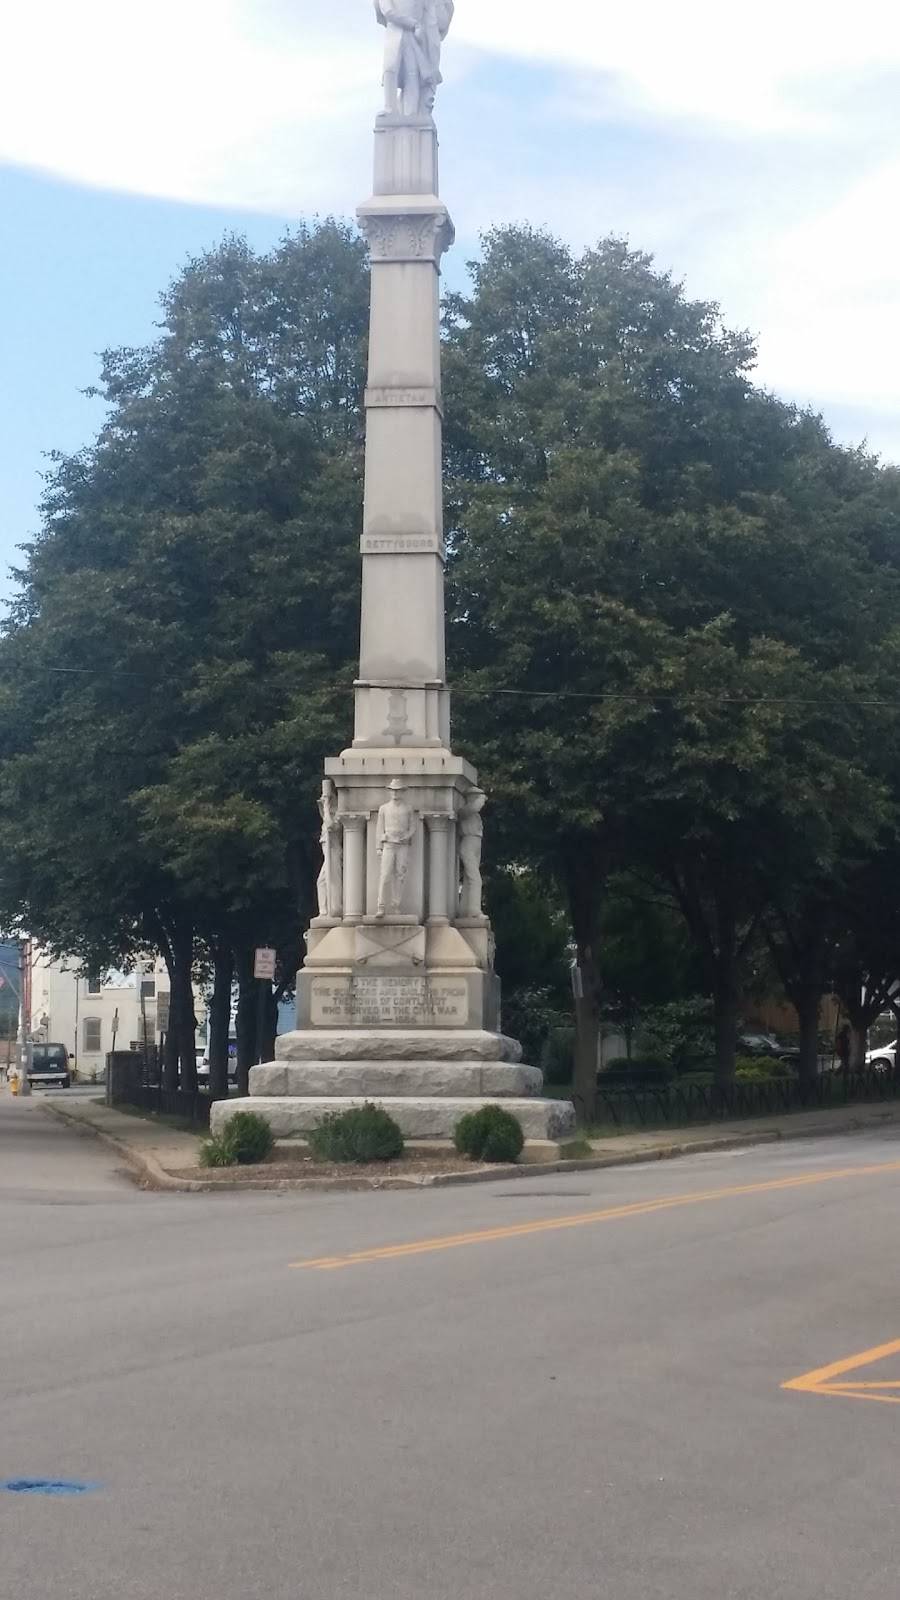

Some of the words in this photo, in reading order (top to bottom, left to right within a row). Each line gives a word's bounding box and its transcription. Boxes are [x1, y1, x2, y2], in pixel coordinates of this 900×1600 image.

[334, 988, 378, 997] SOIERS
[322, 1006, 341, 1015] WHO
[381, 1006, 391, 1015] IN
[392, 1006, 411, 1015] THE
[437, 1006, 458, 1015] WAR
